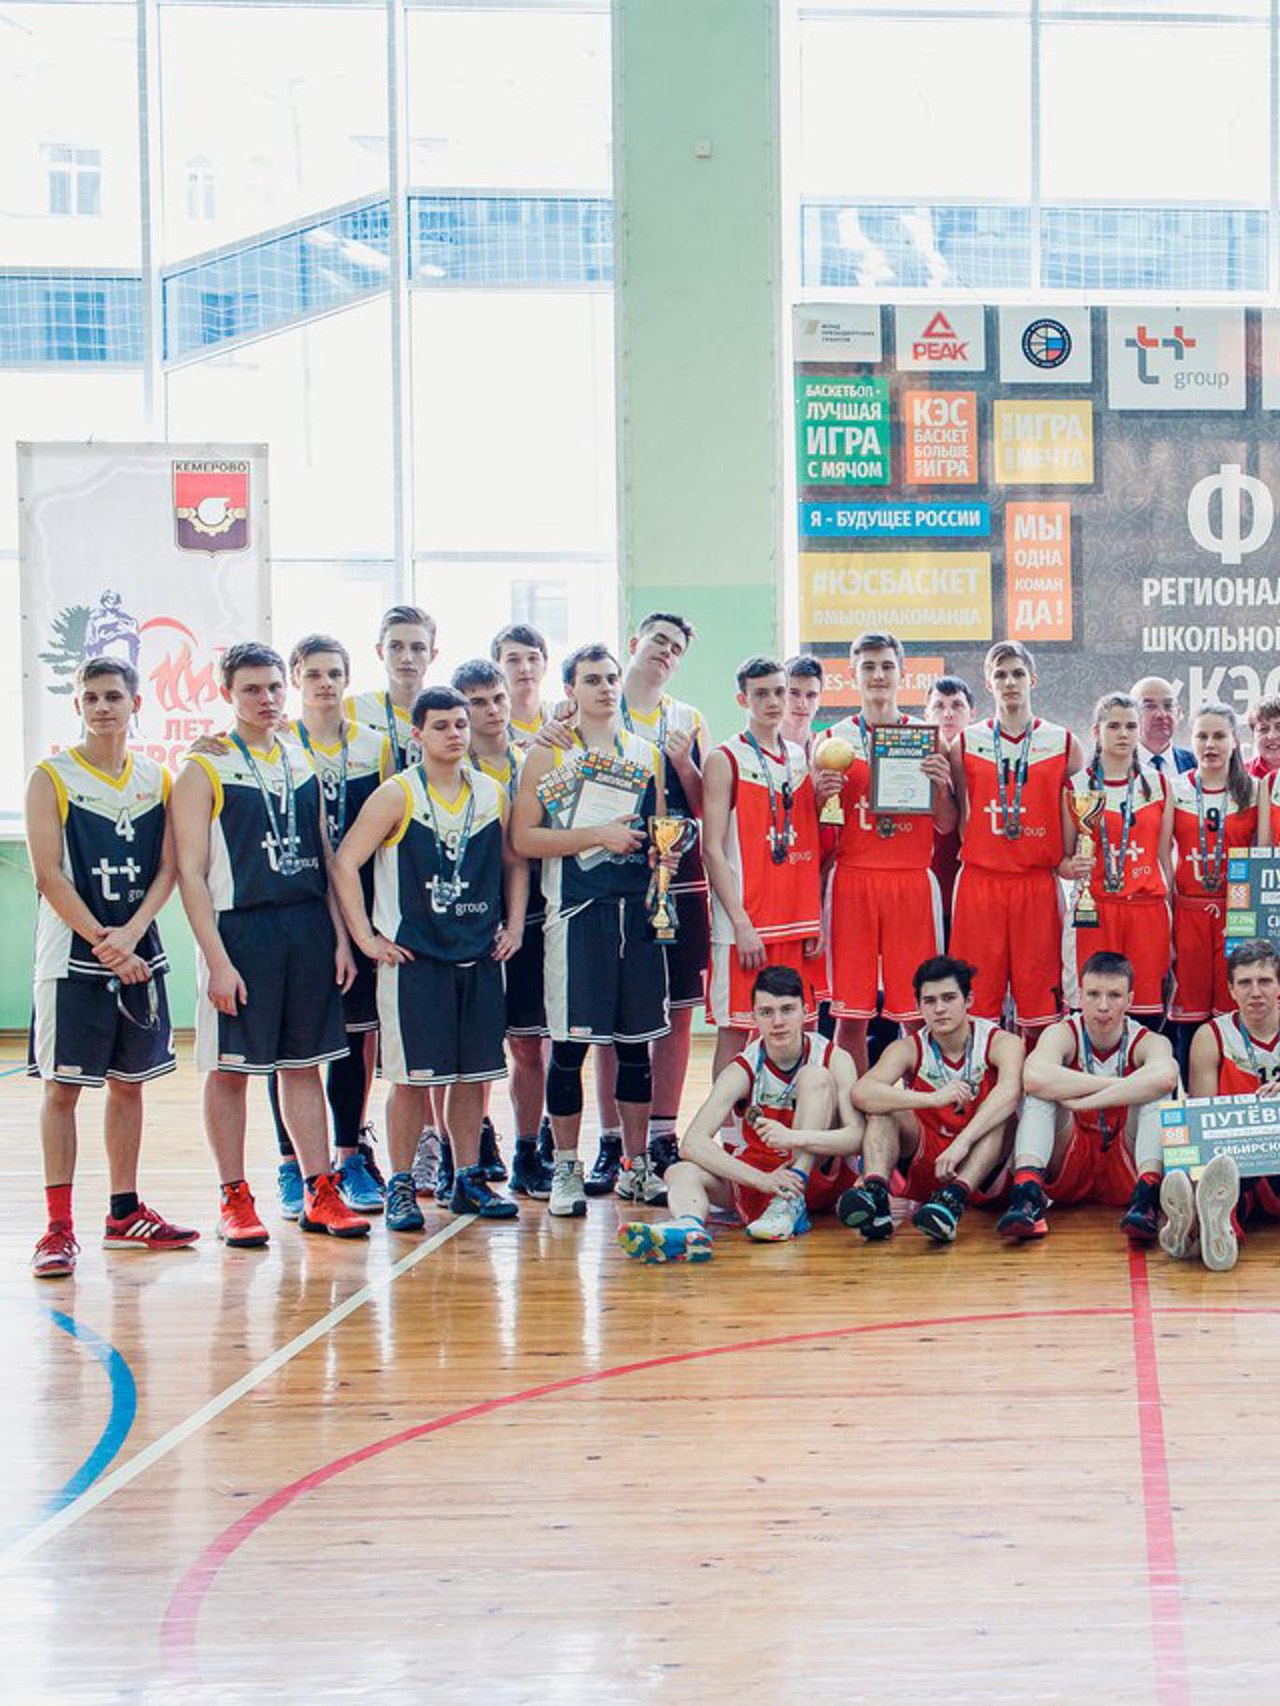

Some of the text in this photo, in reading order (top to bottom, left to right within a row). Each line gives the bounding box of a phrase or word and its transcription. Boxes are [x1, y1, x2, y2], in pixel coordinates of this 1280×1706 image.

[912, 342, 969, 361] PEAK
[1173, 369, 1230, 390] group
[806, 385, 873, 398] БАСКЕТБОЛ
[805, 402, 882, 421] ЛУЧШАЯ
[913, 398, 969, 426] КЭС
[914, 429, 969, 443] БАСКЕТ
[1016, 414, 1085, 441] ИГРА
[807, 426, 881, 456] ИГРА
[914, 445, 969, 459] БОЛЬШЕ
[175, 462, 247, 472] КЕМЕРОВО
[821, 460, 883, 479] МЯЧОМ
[924, 460, 969, 477] ИГРА
[811, 511, 821, 527] Я
[837, 510, 911, 531] БУДУЩЕЕ
[915, 510, 981, 527] РОССИИ
[1014, 514, 1063, 542] МЫ
[1014, 550, 1063, 568] ОДНА
[812, 567, 979, 596] #КЭСБАСКЕТ
[1015, 577, 1063, 592] КОМАН
[163, 720, 214, 741] ЛЕТ
[116, 807, 136, 842] 4
[1206, 807, 1220, 833] 9
[446, 830, 461, 861] 9
[455, 901, 489, 916] group
